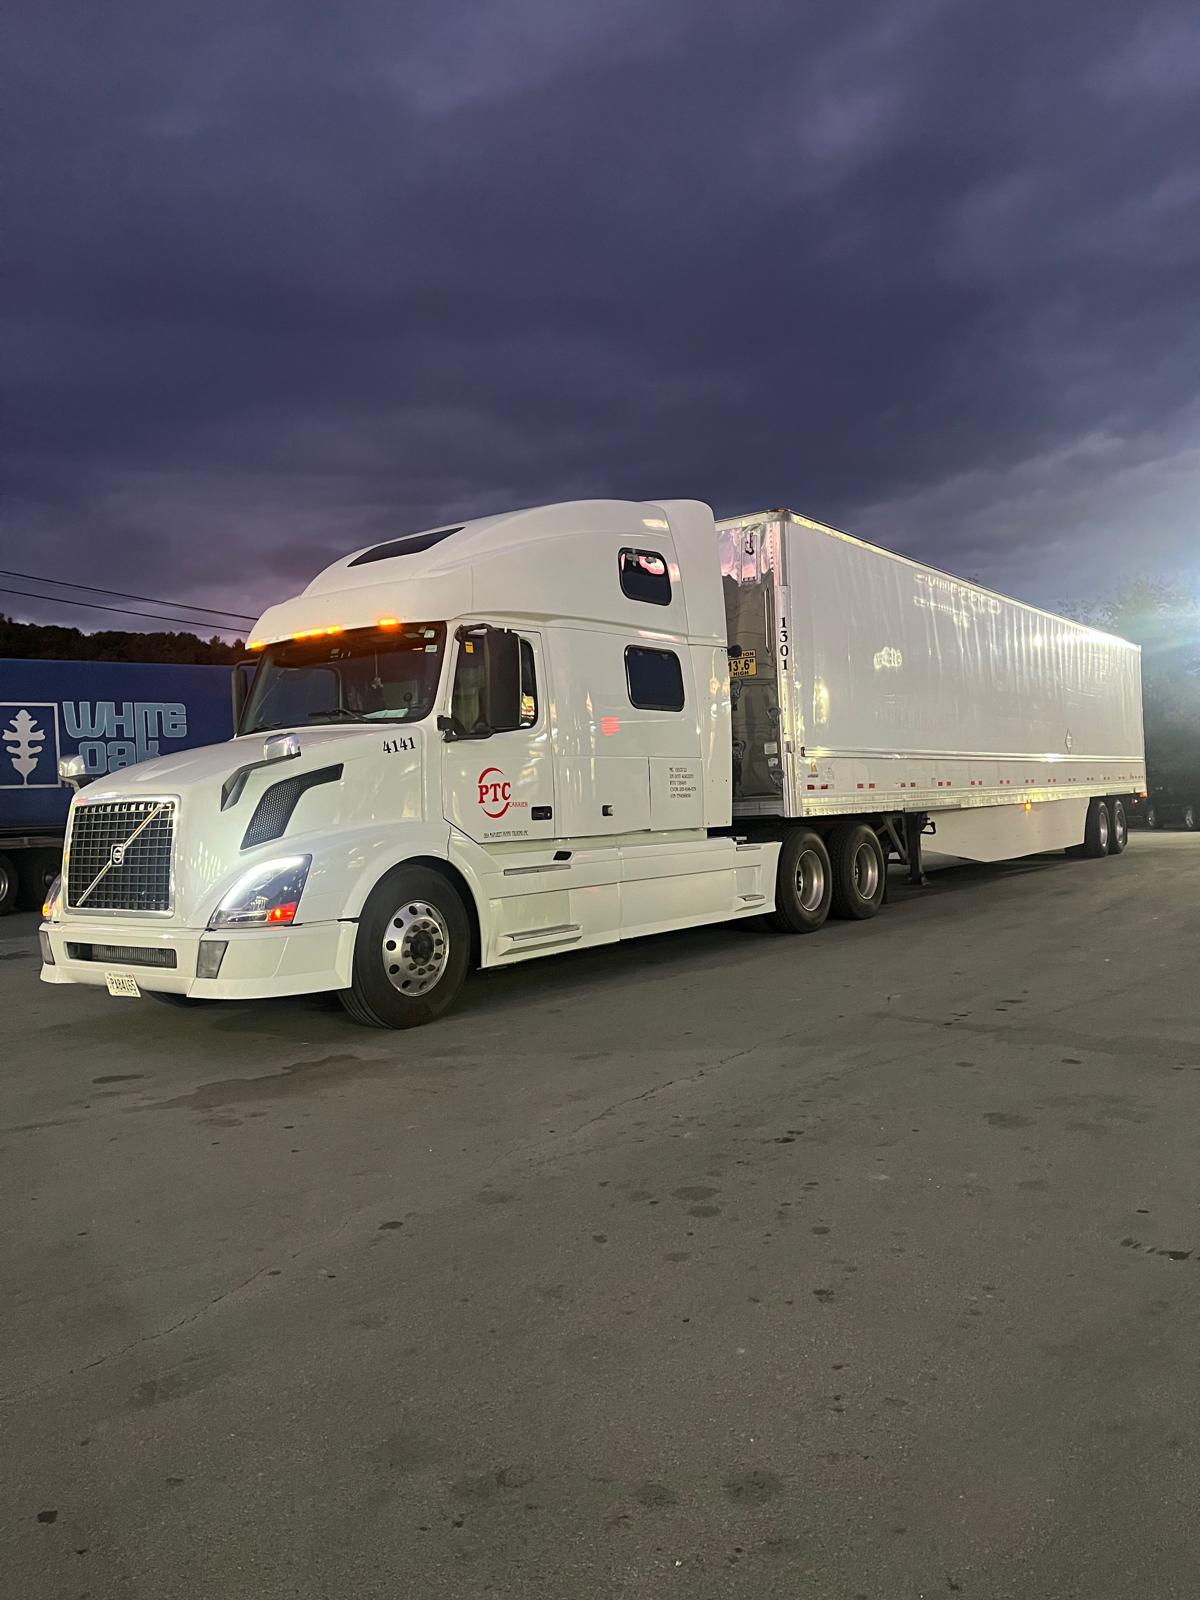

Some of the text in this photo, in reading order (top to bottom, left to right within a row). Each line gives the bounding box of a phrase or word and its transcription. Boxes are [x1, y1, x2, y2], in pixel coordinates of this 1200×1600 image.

[780, 616, 789, 671] 1301
[383, 736, 416, 754] 4141
[478, 782, 511, 804] PTC
